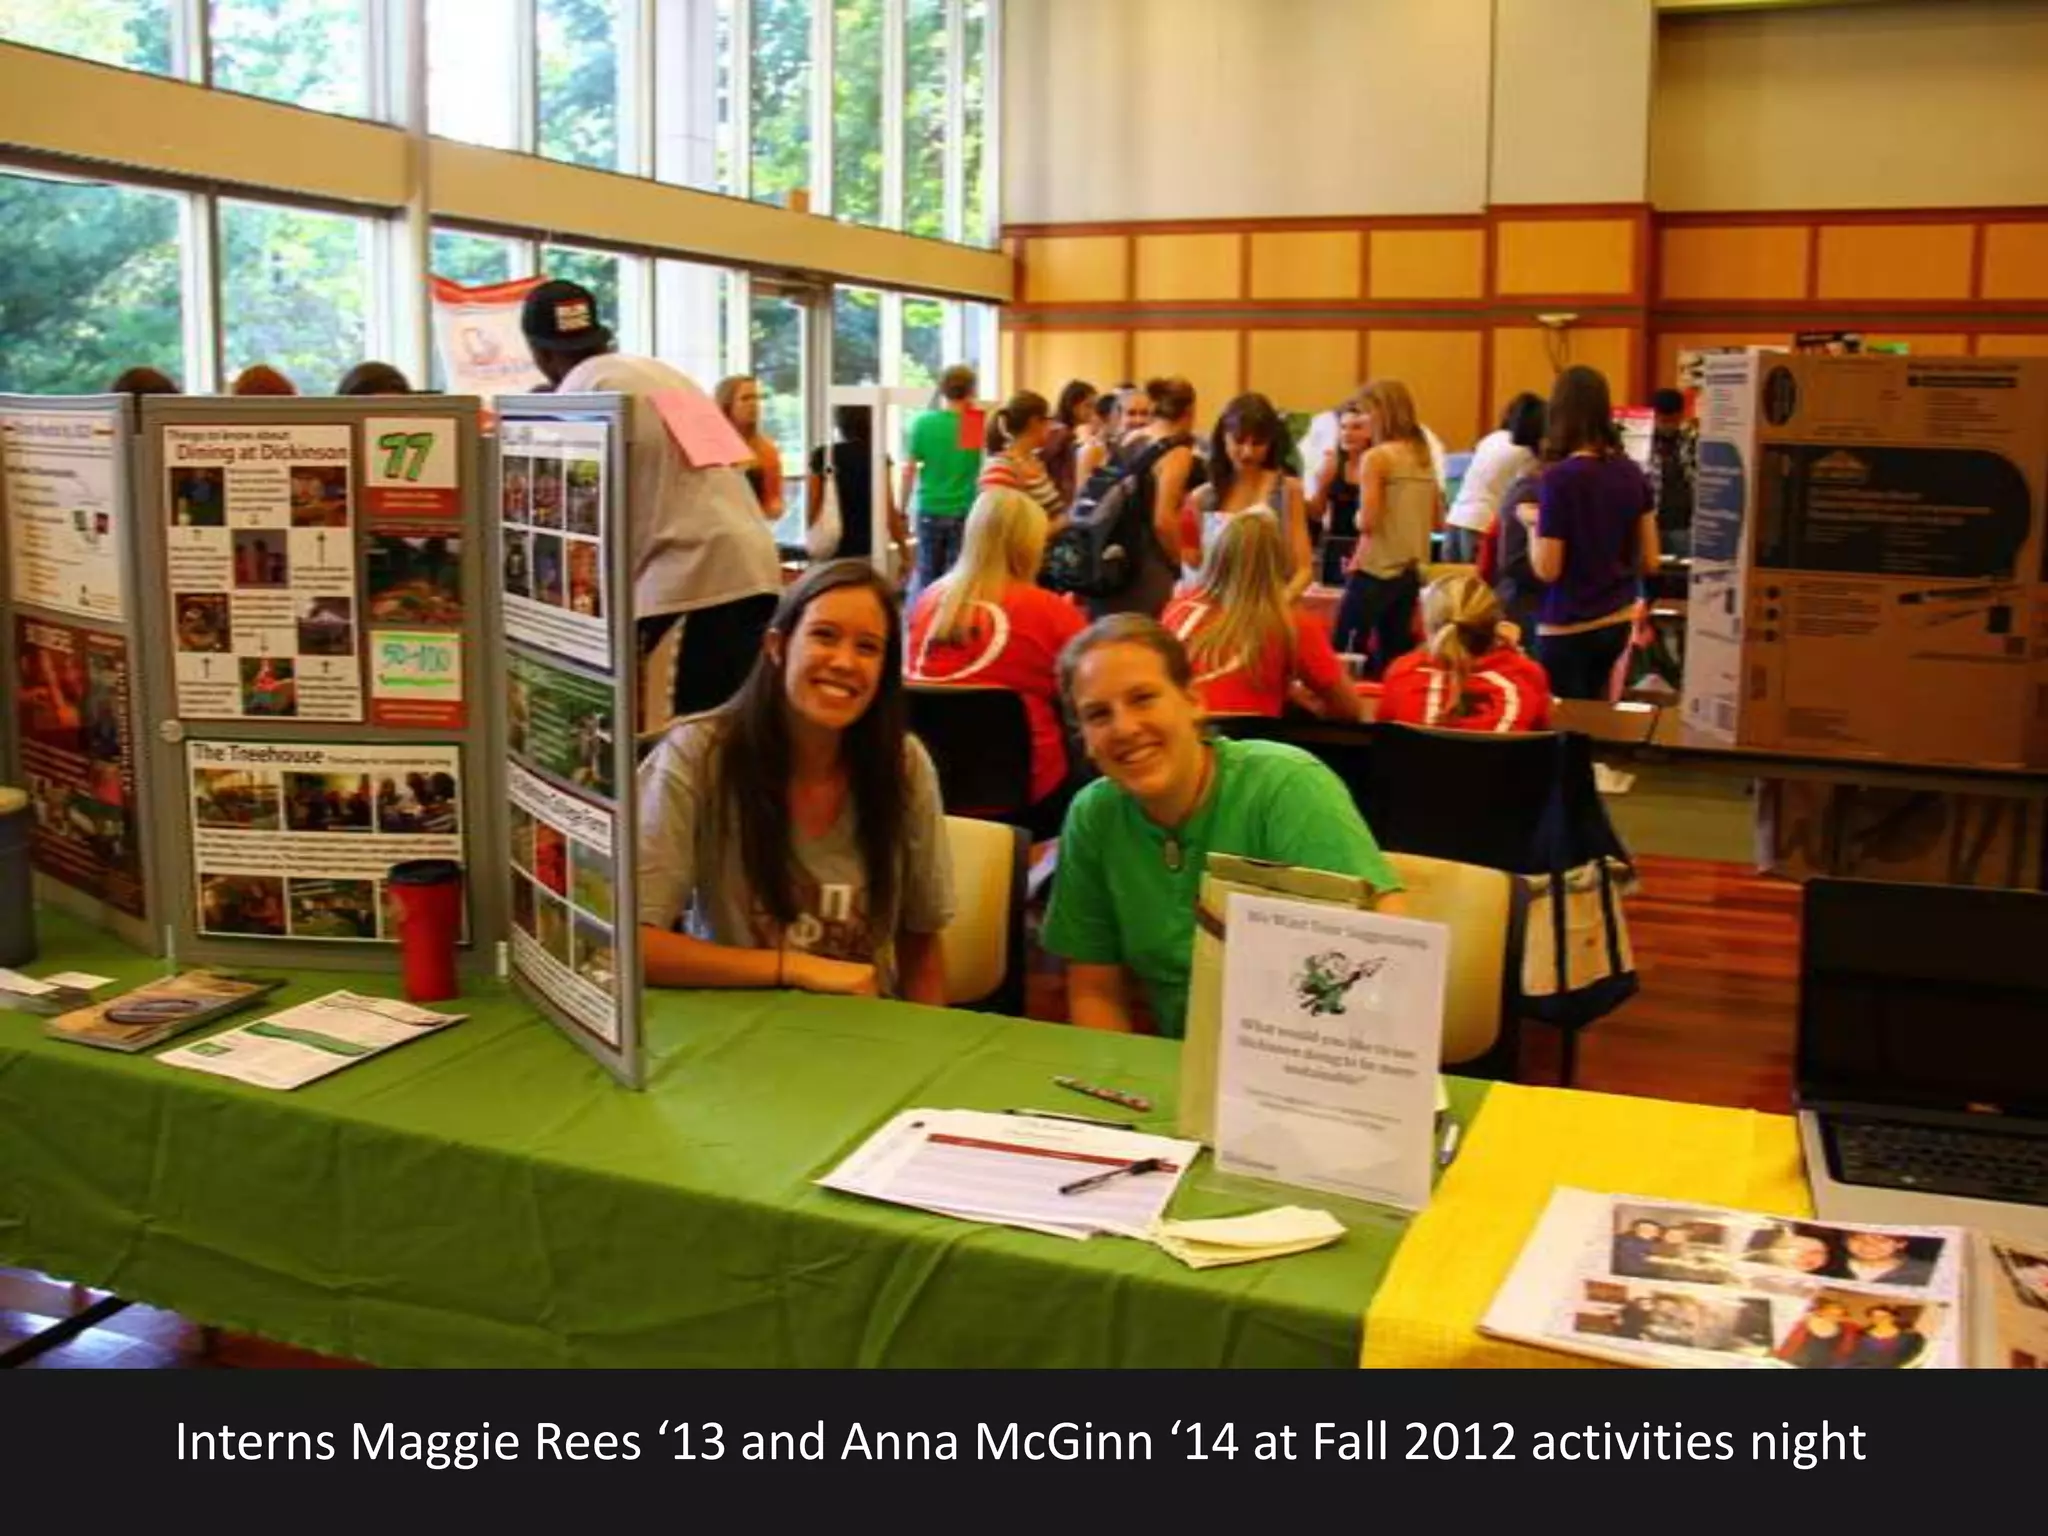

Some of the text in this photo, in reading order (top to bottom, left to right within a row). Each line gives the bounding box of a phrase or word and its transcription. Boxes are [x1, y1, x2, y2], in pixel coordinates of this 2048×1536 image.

[177, 443, 347, 465] Dining at Dickinson
[193, 742, 225, 762] The
[228, 744, 326, 764] Treehouse
